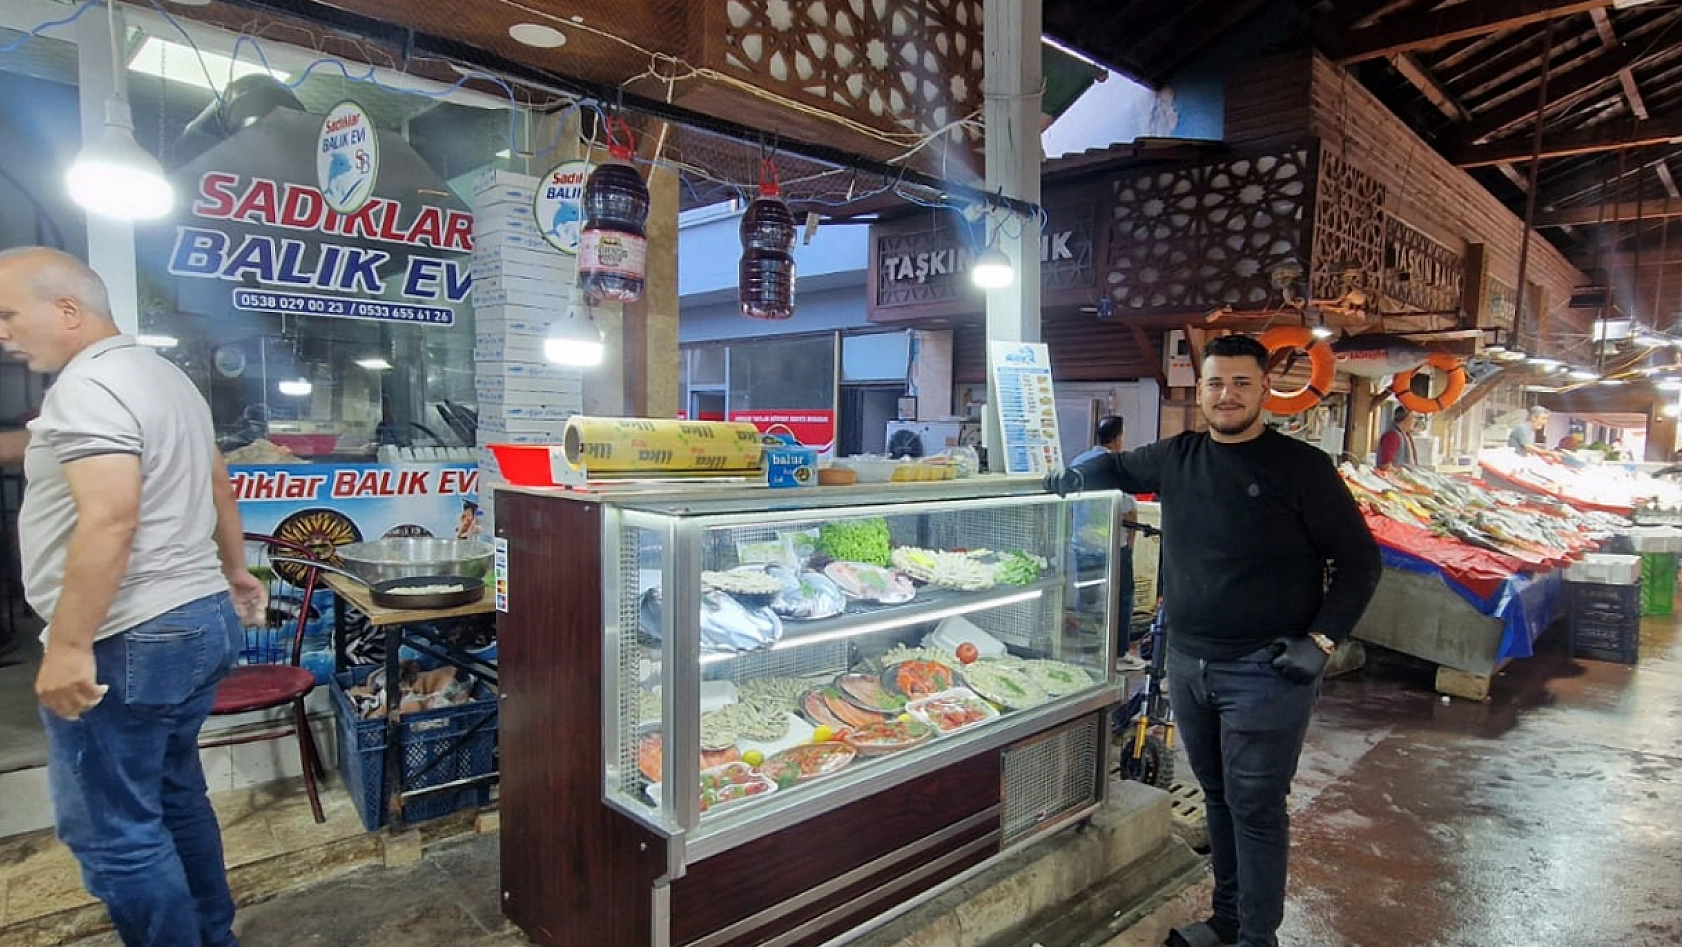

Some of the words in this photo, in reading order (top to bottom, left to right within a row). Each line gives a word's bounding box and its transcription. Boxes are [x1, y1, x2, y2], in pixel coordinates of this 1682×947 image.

[322, 132, 349, 152] BALIK
[195, 172, 474, 250] SADIKLAR
[168, 226, 389, 293] BALIK
[403, 254, 473, 302] EV
[241, 294, 276, 308] 0538
[280, 297, 305, 310] 029
[308, 300, 324, 312] 00
[328, 301, 344, 313] 23
[359, 304, 389, 317] 0533
[392, 308, 413, 319] 655
[417, 309, 431, 320] 61
[434, 311, 449, 322] 26
[230, 473, 324, 499] dıklar
[333, 471, 430, 497] BALIK
